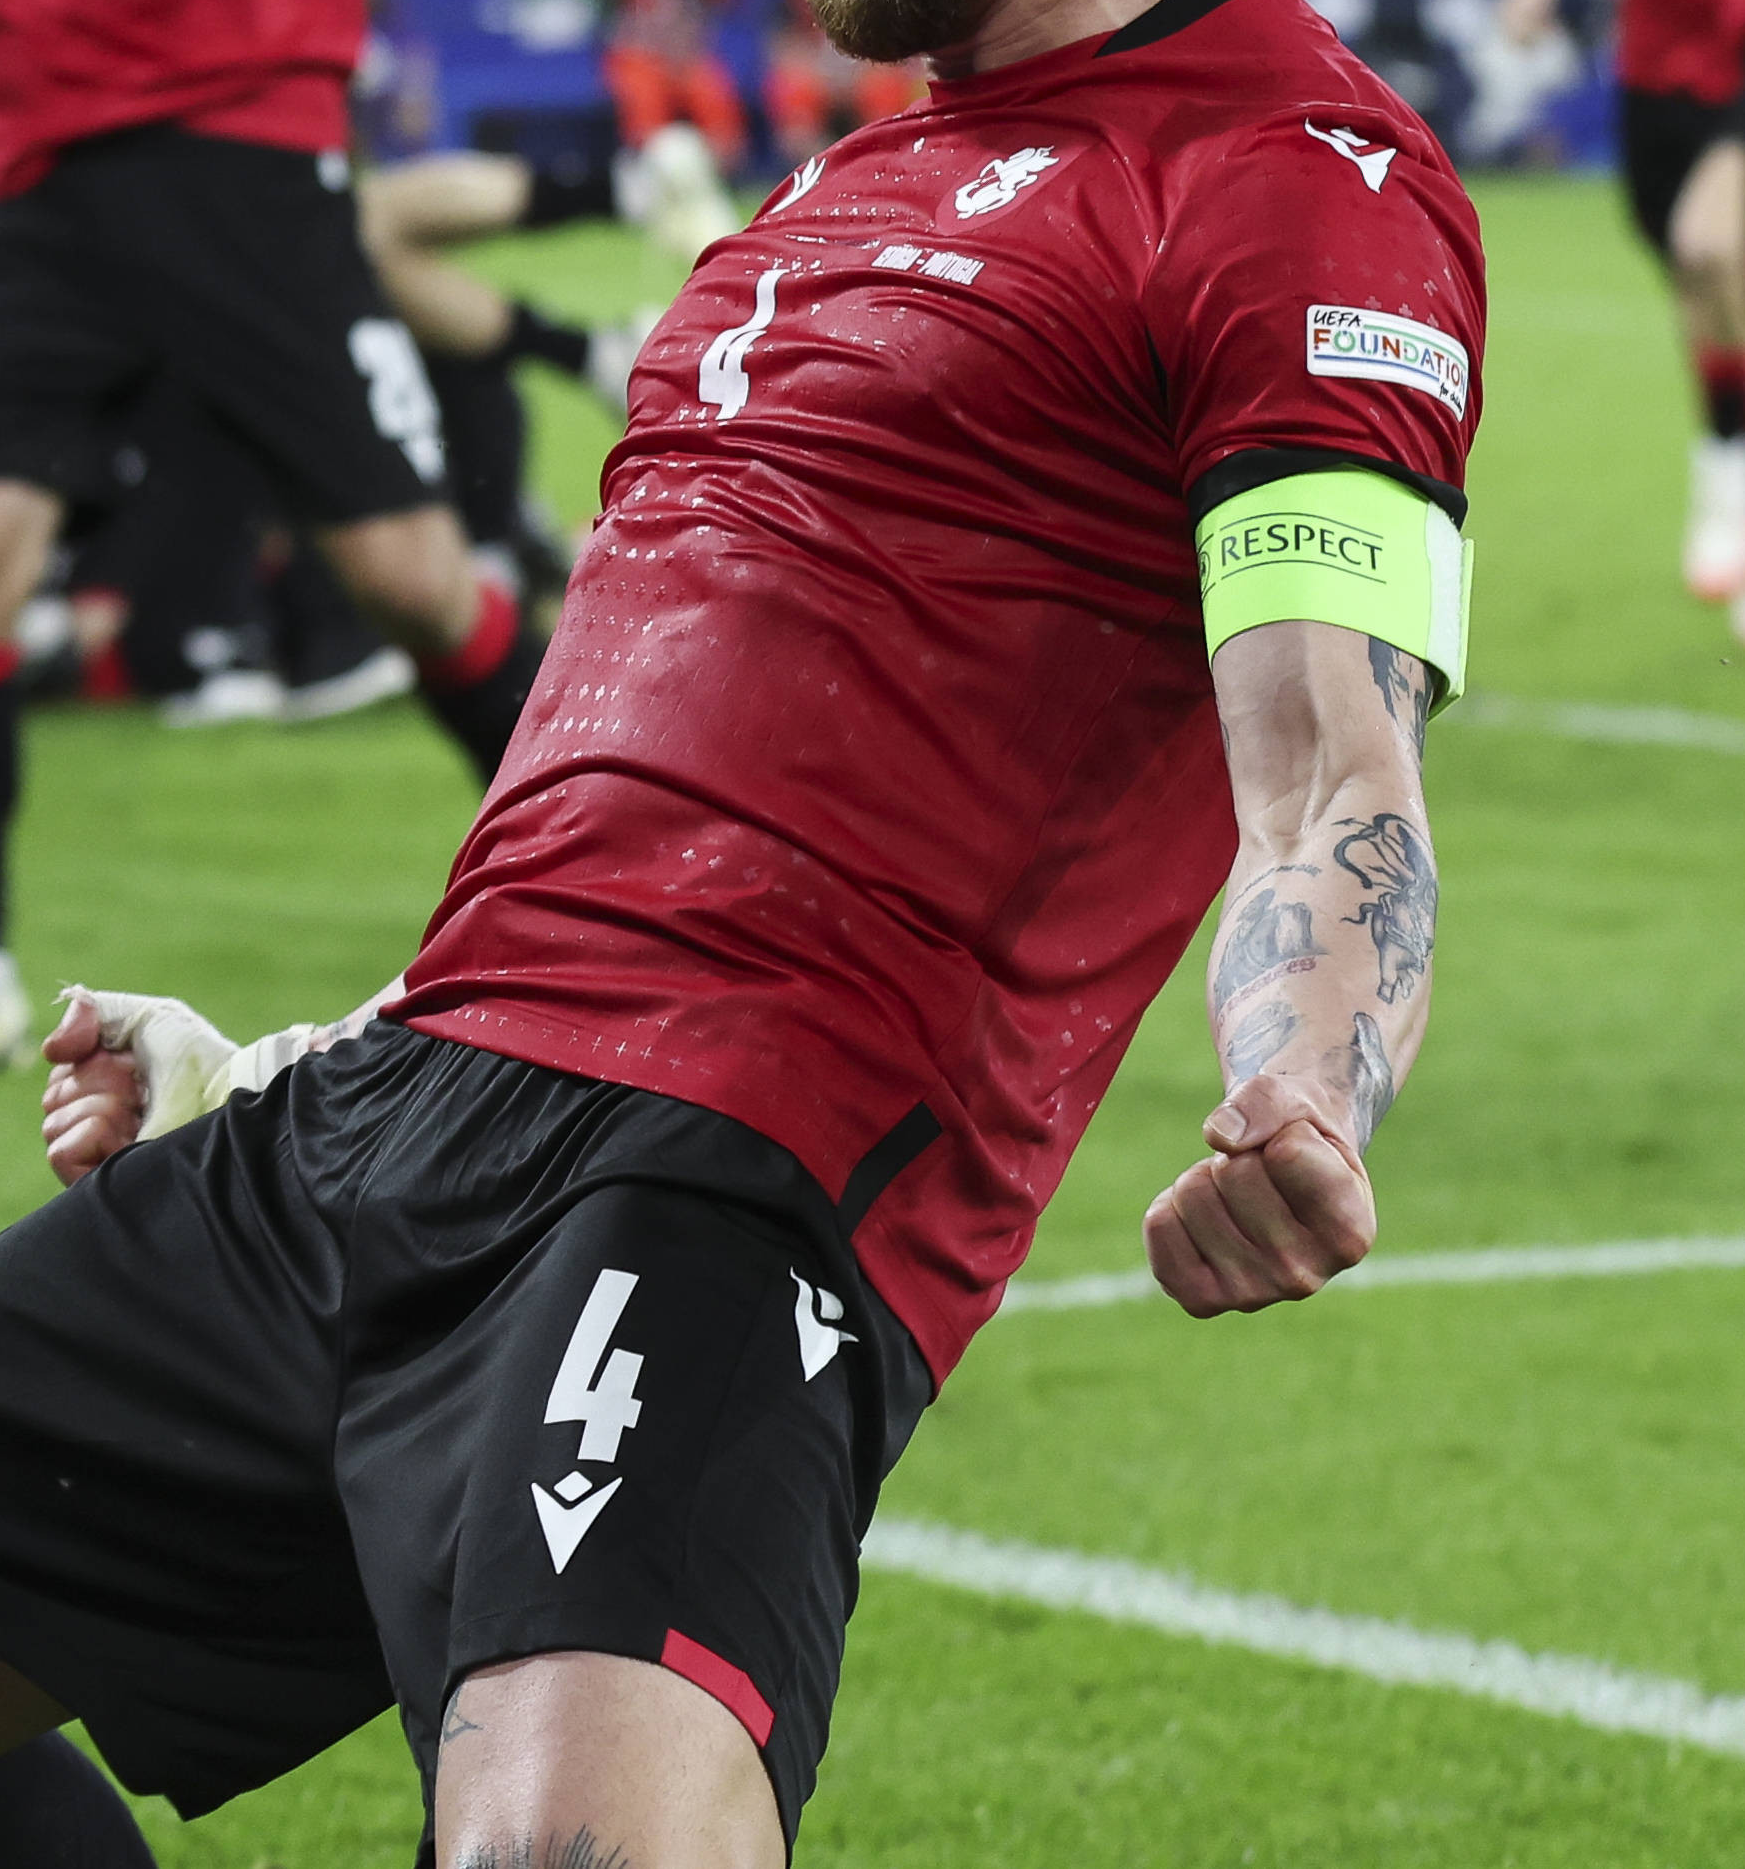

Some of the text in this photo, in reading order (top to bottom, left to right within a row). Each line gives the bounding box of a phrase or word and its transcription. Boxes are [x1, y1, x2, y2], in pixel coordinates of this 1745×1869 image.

[699, 268, 790, 420] 4
[1313, 309, 1362, 328] UEFA
[1313, 328, 1466, 398] FOUNDATION
[1220, 523, 1383, 571] RESPECT
[543, 1268, 645, 1463] 4
